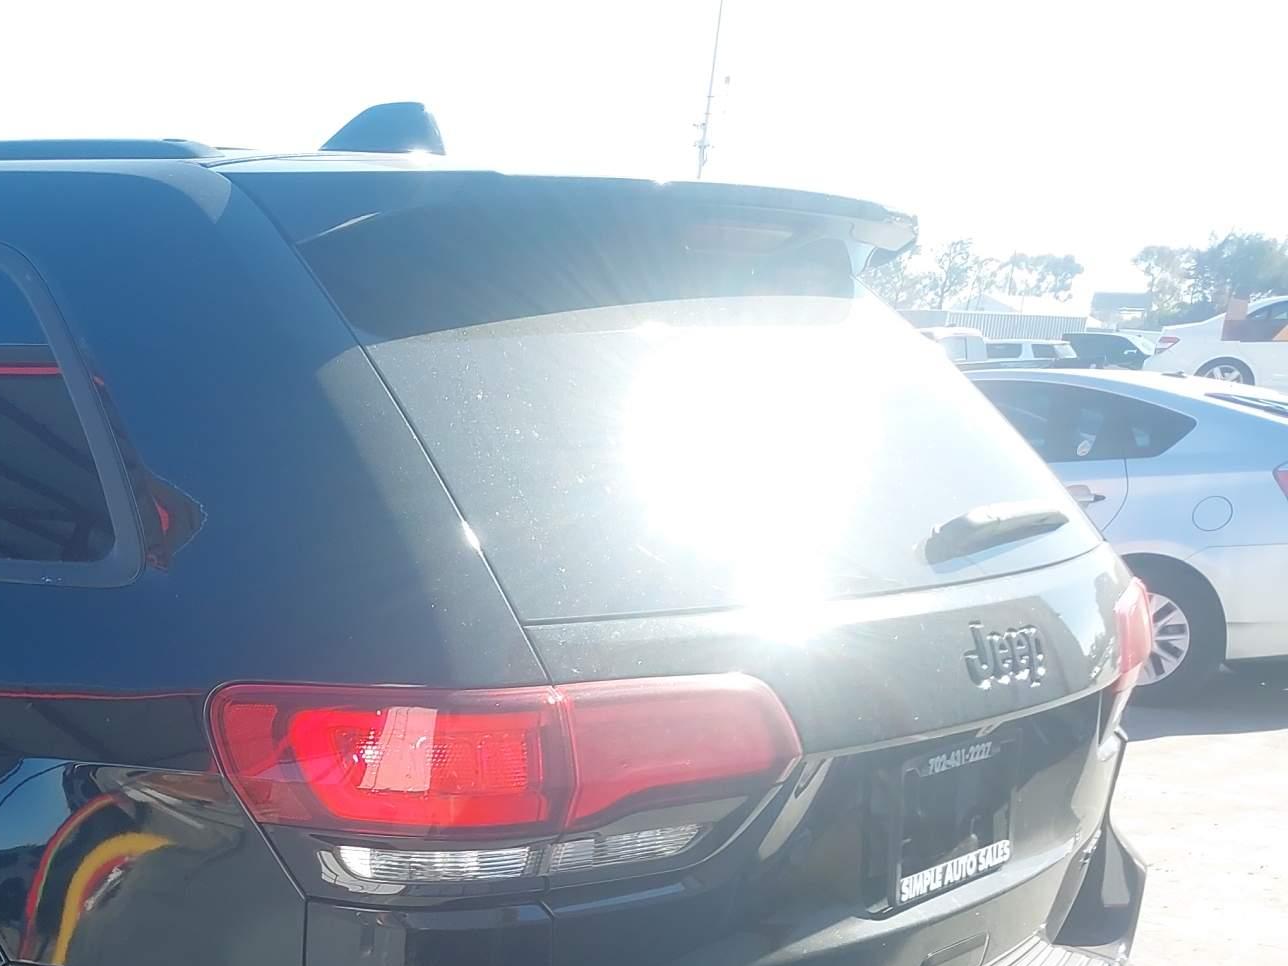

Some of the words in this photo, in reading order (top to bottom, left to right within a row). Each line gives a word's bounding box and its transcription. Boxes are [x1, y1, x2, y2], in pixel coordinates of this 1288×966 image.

[963, 620, 1046, 690] Jeep
[900, 865, 943, 902] SIMPLE
[944, 853, 977, 885] AUTO
[978, 840, 1010, 872] SALES
